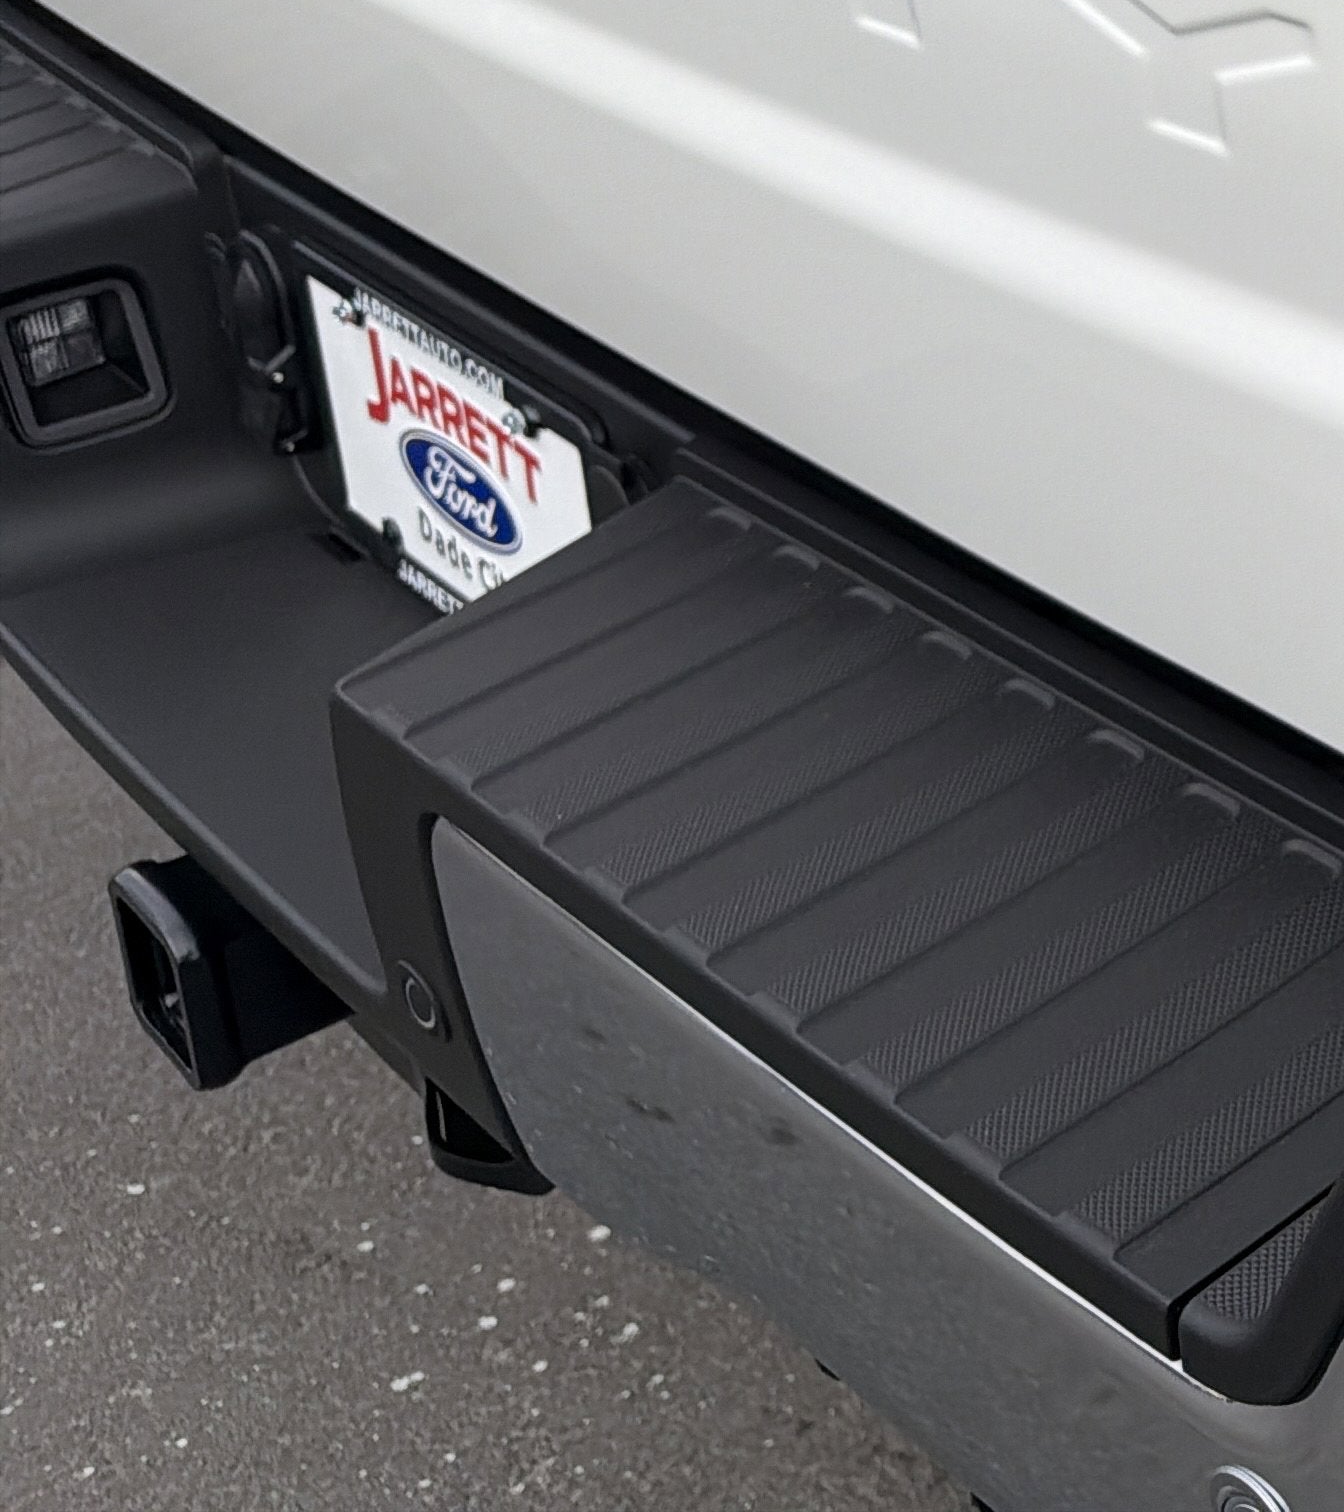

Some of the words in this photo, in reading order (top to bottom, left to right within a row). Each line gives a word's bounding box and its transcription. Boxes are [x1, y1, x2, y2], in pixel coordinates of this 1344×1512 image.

[353, 287, 504, 402] JARRETTAUTO.COM
[366, 327, 542, 505] JARRETT
[424, 444, 498, 538] Ford
[417, 506, 474, 582] Dade
